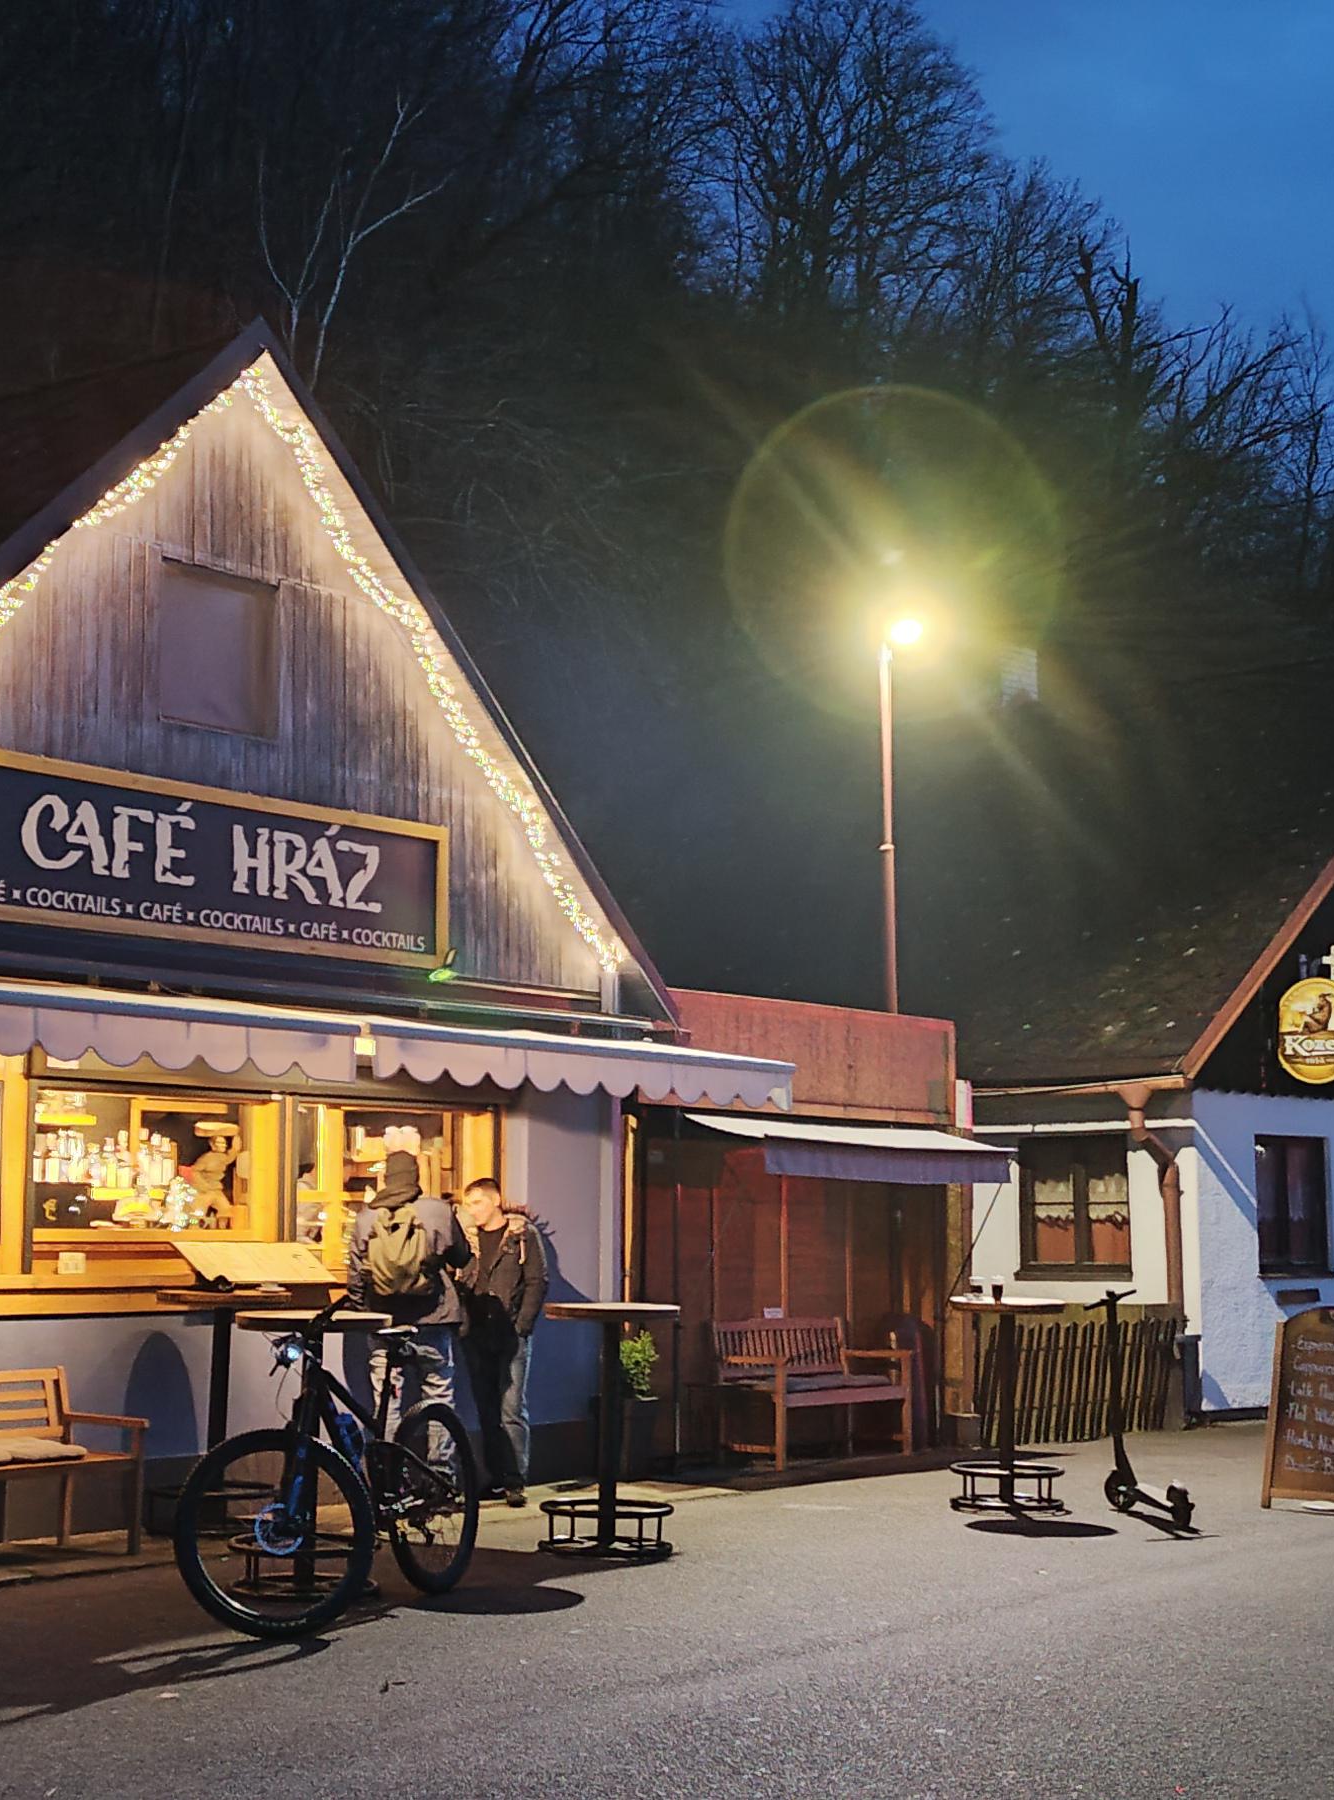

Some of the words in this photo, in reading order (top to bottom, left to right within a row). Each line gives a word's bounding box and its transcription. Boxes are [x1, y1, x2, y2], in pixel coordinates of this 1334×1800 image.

[21, 794, 196, 887] CAFÉ
[232, 824, 382, 913] HRÁZ
[25, 886, 121, 916] COCKTAILS
[139, 901, 182, 923] CAFÉ
[199, 909, 284, 935] COCKTAILS
[300, 921, 338, 941] CAFÉ
[352, 927, 425, 952] COCKTAILS
